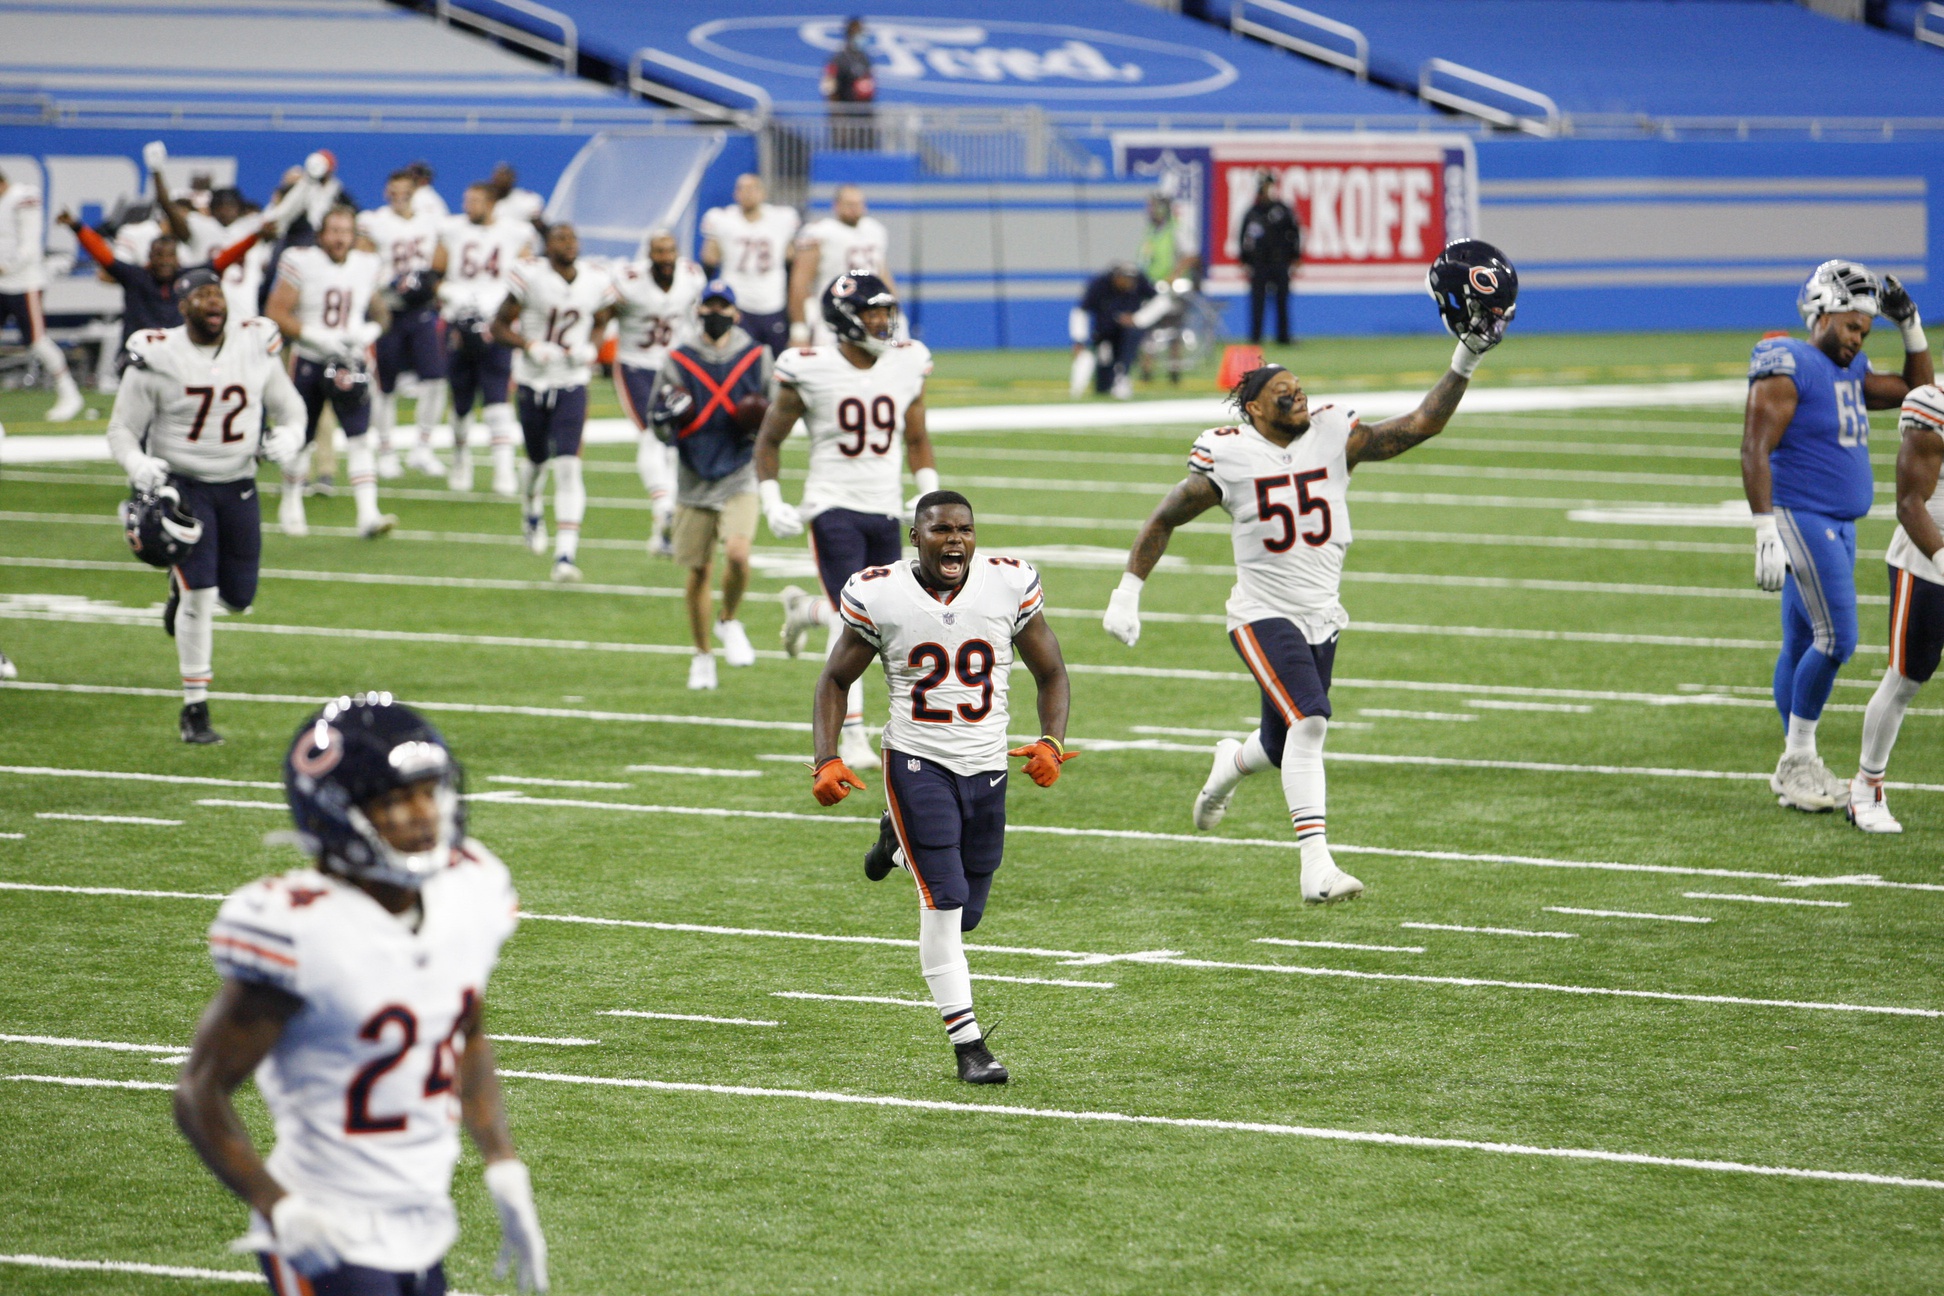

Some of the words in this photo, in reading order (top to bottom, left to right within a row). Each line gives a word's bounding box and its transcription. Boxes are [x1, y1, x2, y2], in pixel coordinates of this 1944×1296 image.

[1224, 166, 1433, 259] KCKOFF
[324, 287, 352, 328] 81
[547, 306, 580, 350] 12
[185, 384, 248, 443] 72
[837, 394, 896, 458] 99
[1253, 467, 1333, 554] 55
[907, 638, 996, 724] 29
